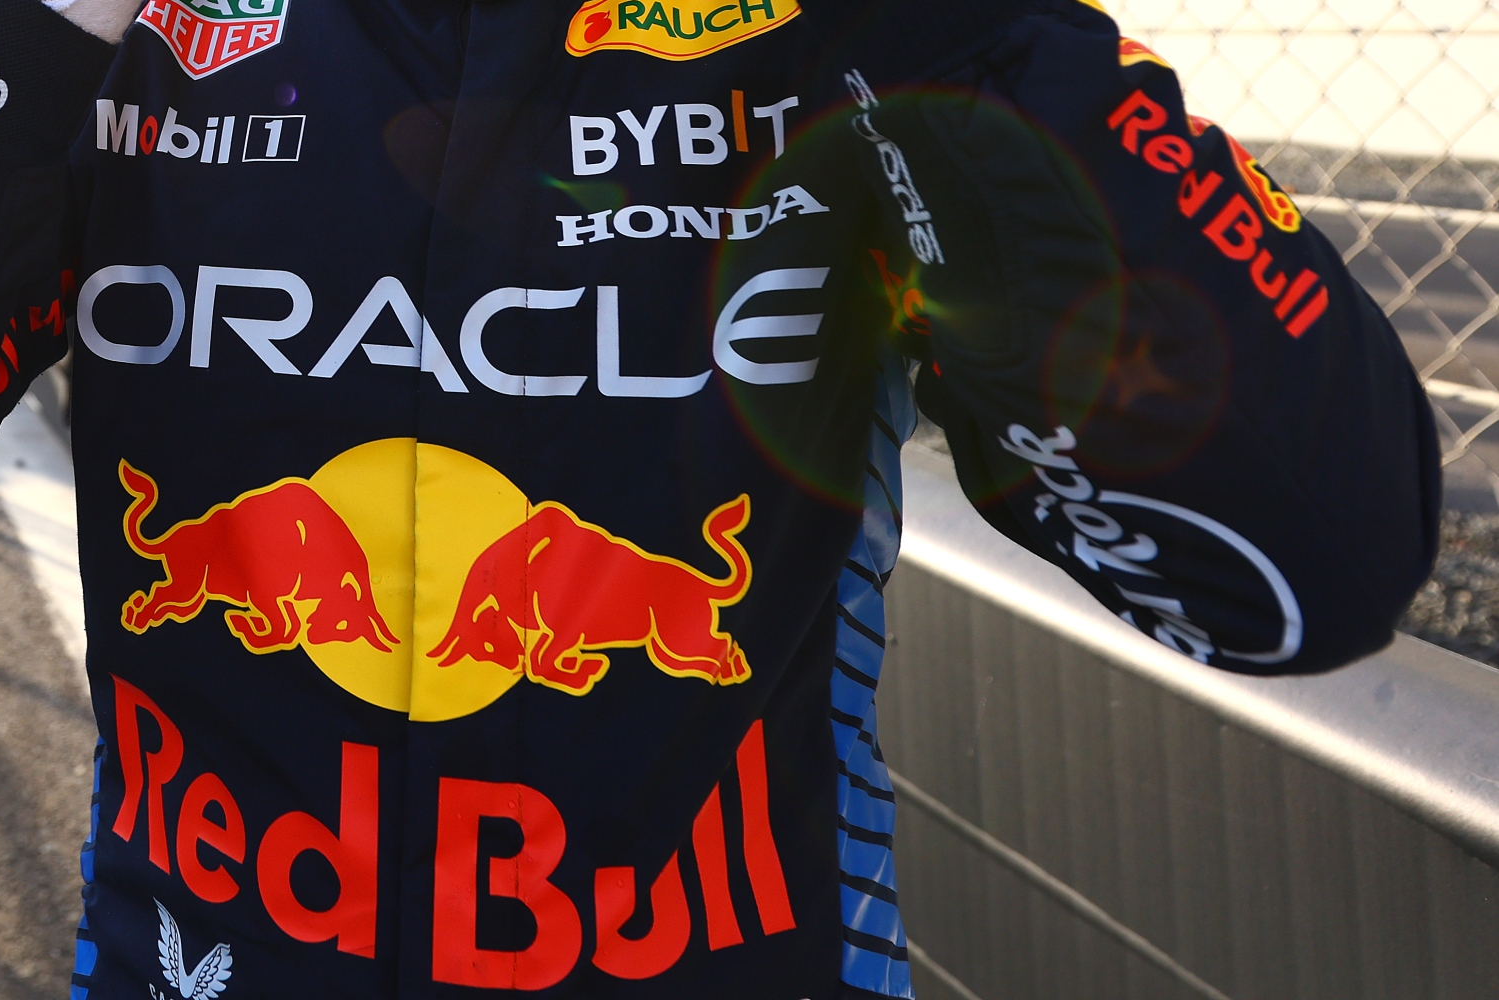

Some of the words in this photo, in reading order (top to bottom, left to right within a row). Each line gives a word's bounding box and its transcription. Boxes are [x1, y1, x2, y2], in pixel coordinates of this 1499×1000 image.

[146, 0, 274, 70] HEUER
[96, 99, 236, 164] Mobil
[262, 119, 282, 158] 1
[569, 89, 800, 176] BYBIT
[556, 185, 830, 247] HONDA
[1107, 89, 1224, 218] Red
[1202, 193, 1329, 338] Bull
[77, 265, 831, 398] ORACLE
[111, 673, 379, 960] Red
[432, 719, 798, 992] Bull
